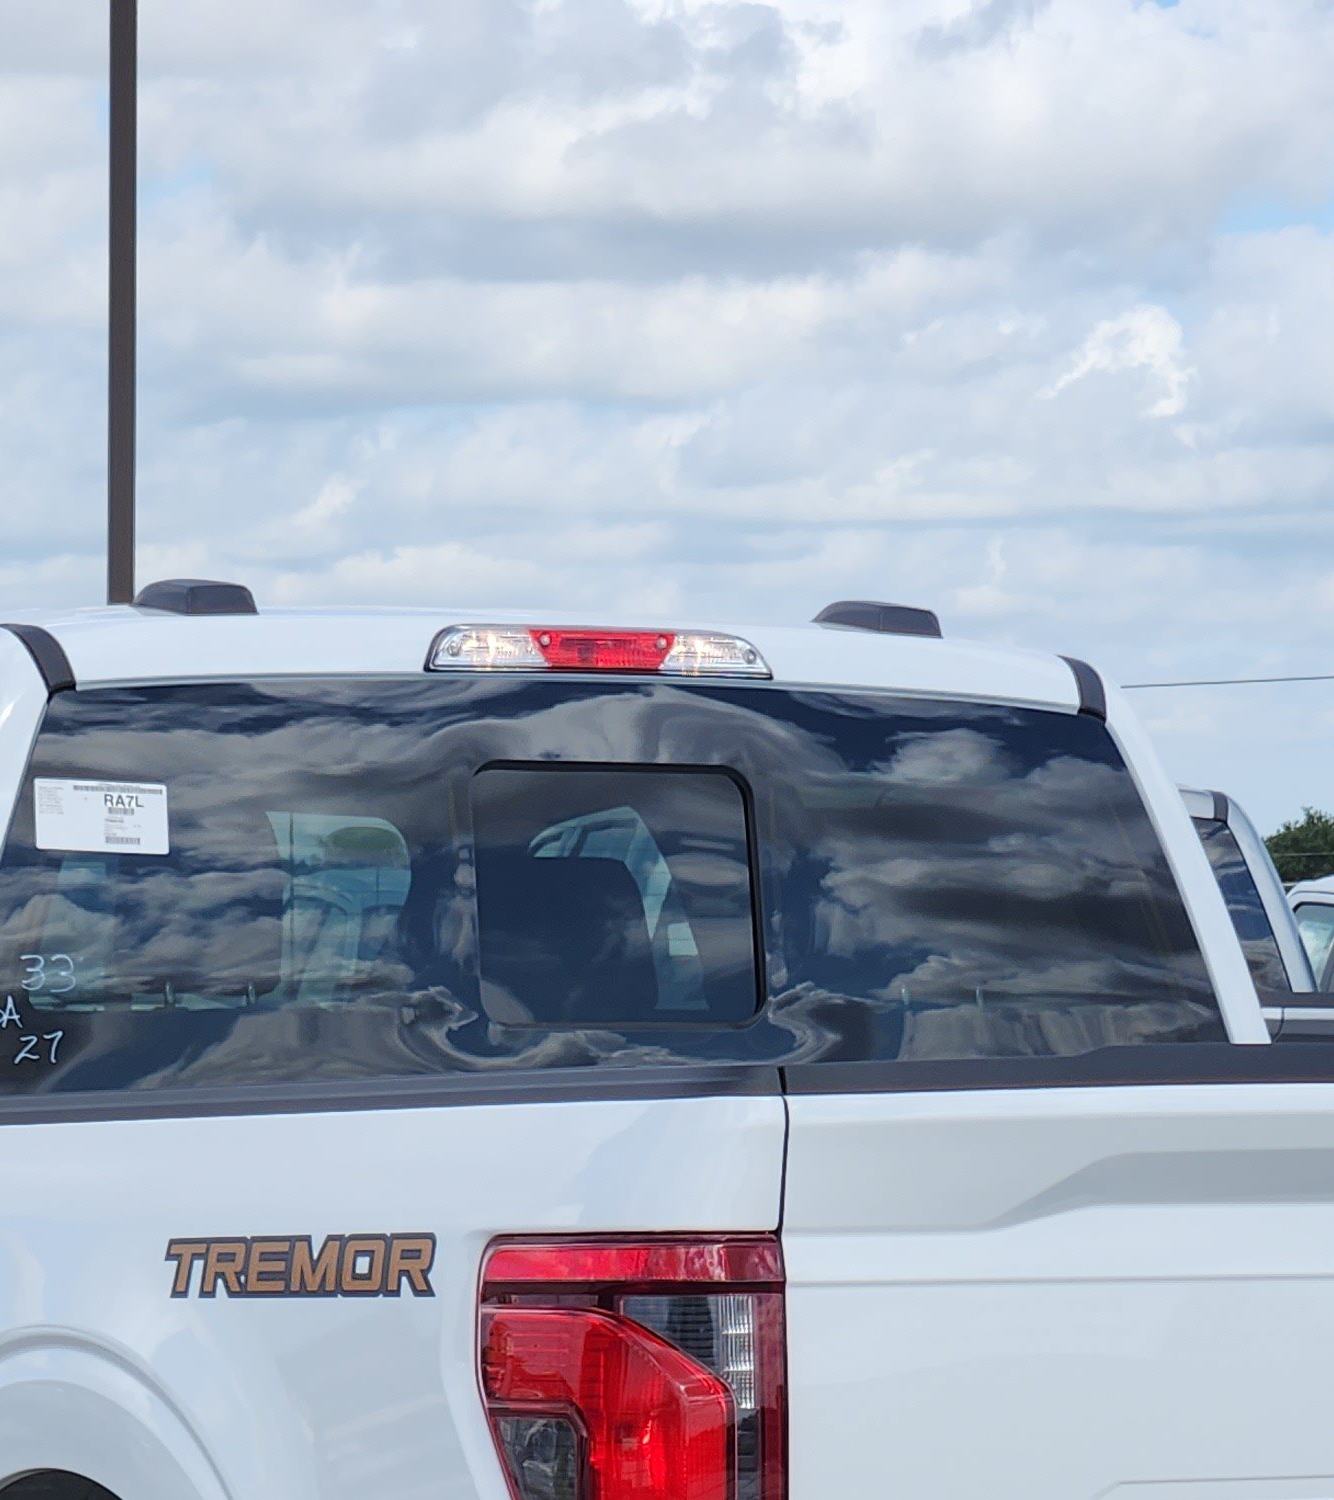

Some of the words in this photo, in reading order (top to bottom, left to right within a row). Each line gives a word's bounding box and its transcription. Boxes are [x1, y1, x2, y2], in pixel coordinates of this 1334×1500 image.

[104, 793, 144, 808] RA7L
[20, 954, 76, 992] 33
[14, 1030, 63, 1065] 27
[165, 1232, 437, 1298] TREMOR
